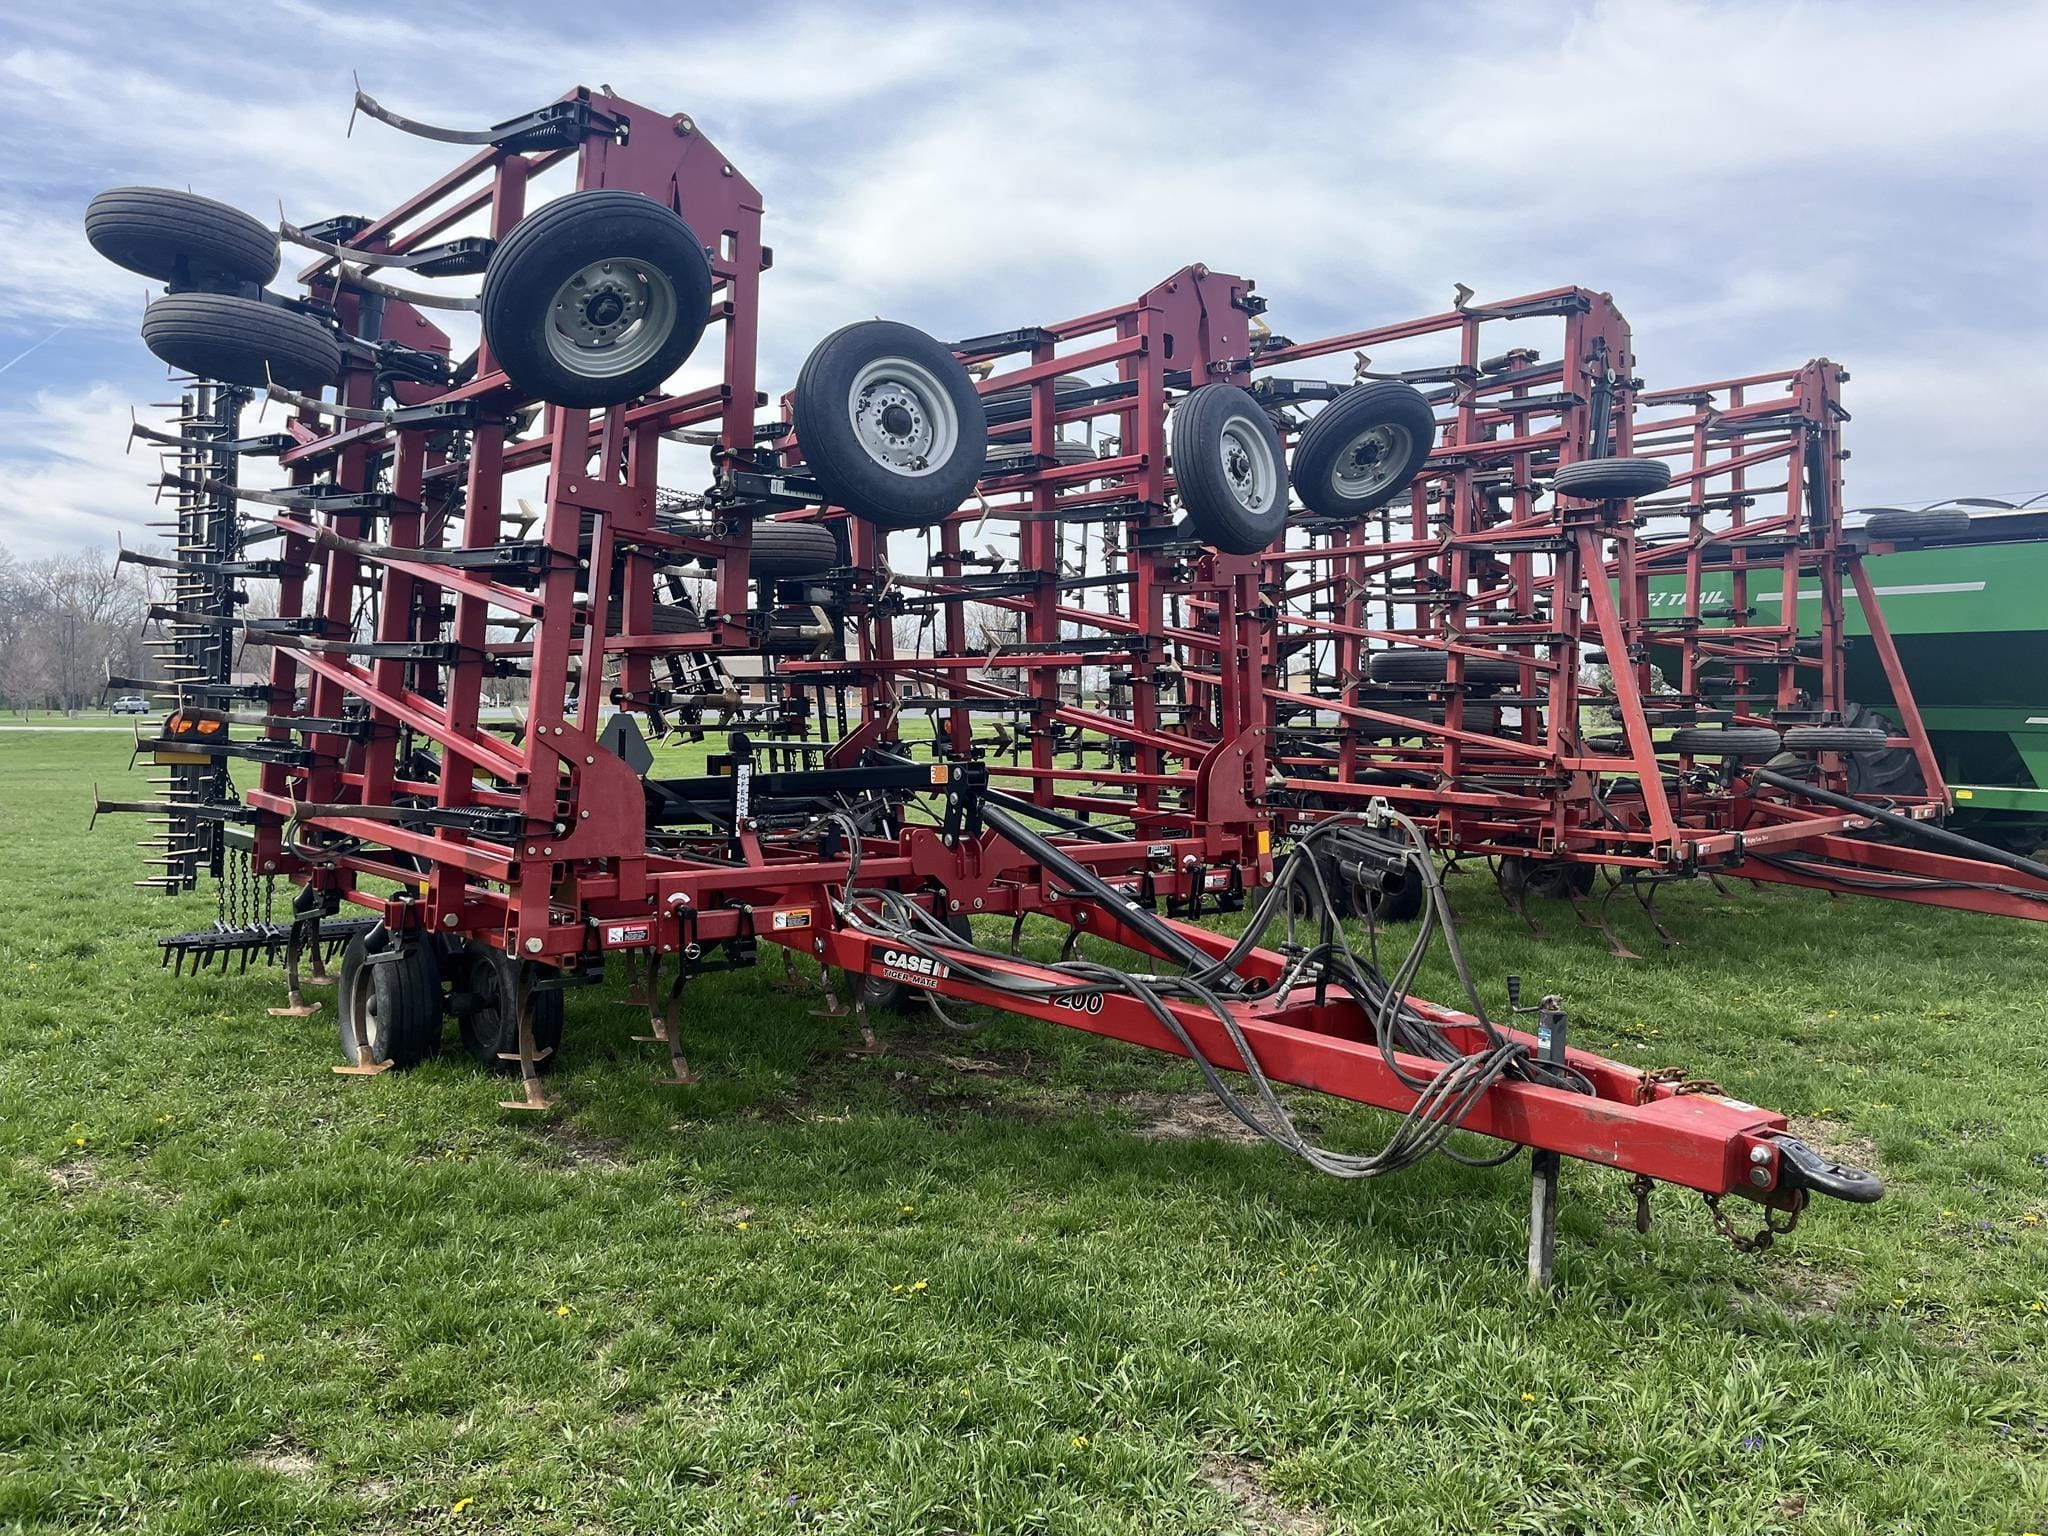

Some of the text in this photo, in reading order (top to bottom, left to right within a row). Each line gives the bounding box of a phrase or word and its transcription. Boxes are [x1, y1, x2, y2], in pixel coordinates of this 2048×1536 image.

[1668, 591, 1726, 606] TAIL
[884, 950, 933, 975] CASE
[883, 968, 938, 989] TIGER-MATE
